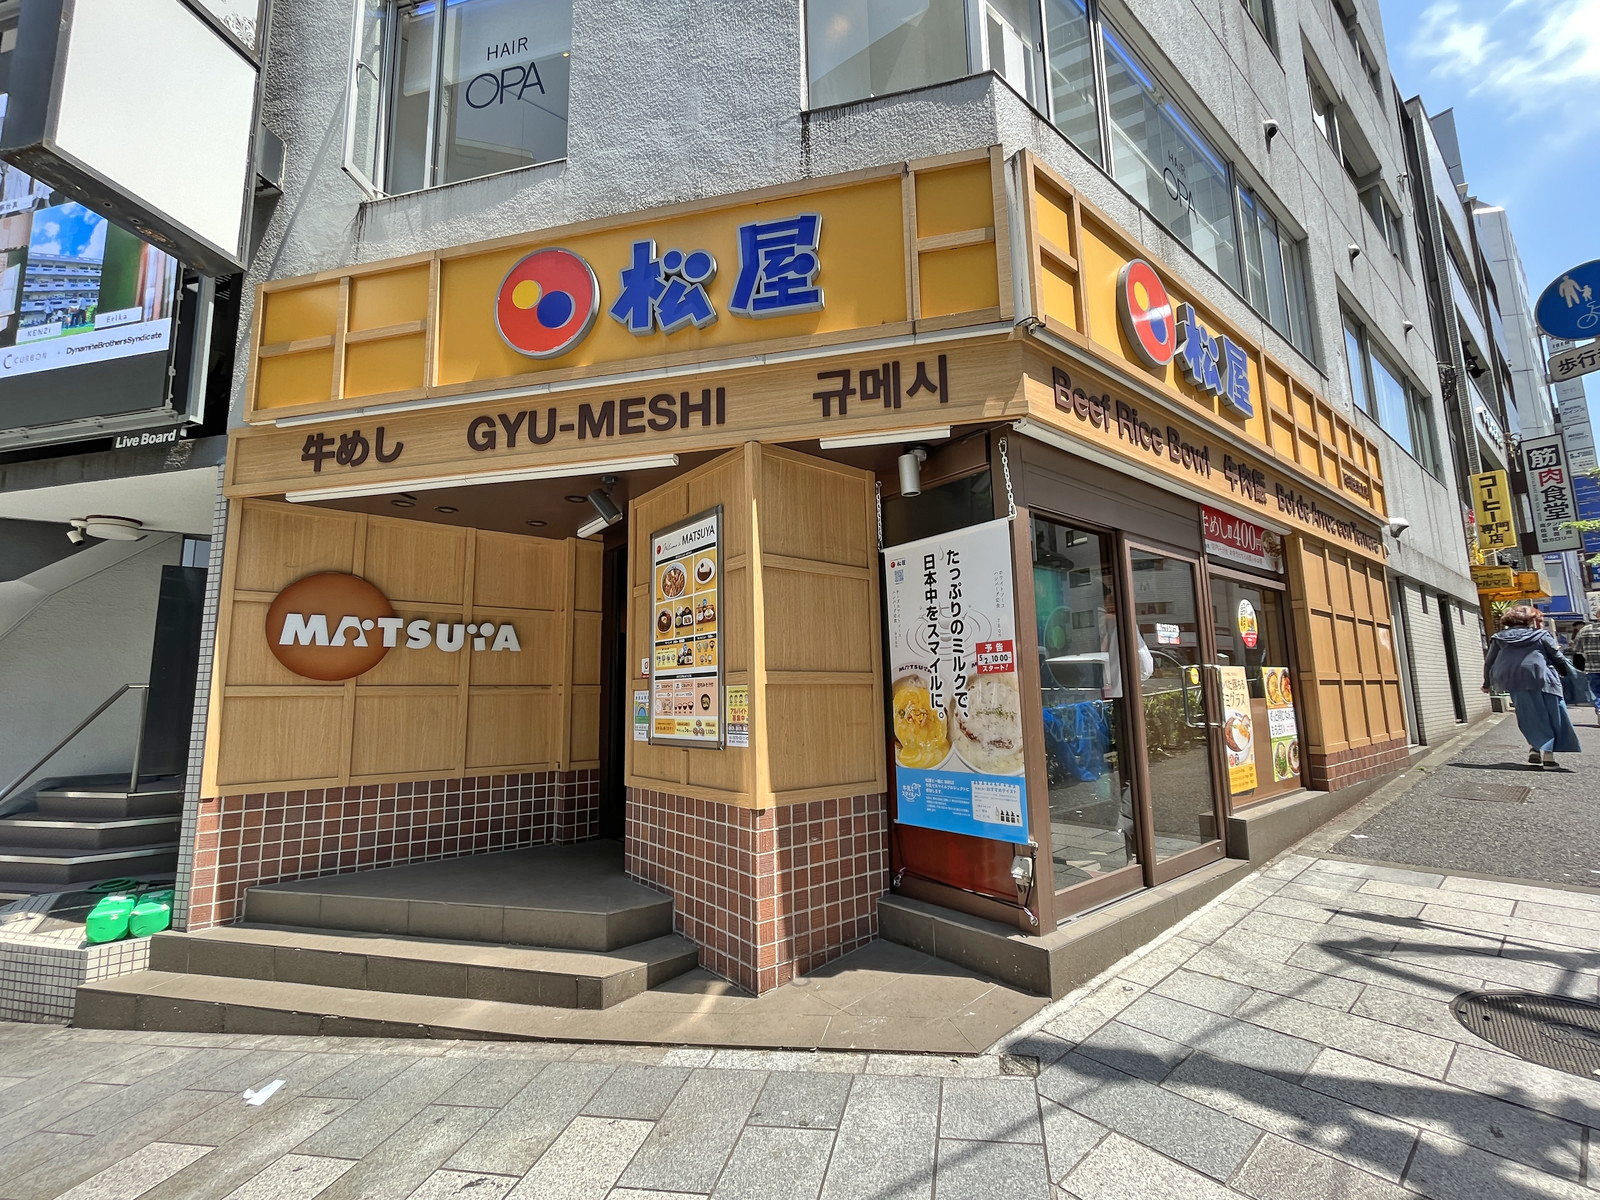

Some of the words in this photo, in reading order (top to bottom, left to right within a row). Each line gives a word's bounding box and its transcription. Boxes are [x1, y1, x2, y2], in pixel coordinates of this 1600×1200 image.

[487, 37, 528, 61] HAIR
[465, 62, 546, 109] OPA
[1168, 150, 1187, 179] HAIR
[1163, 167, 1199, 225] OPA
[608, 212, 826, 337] 松屋
[26, 328, 51, 337] KENZI
[1174, 302, 1254, 420] 松屋
[1557, 348, 1600, 376] 歩行
[812, 355, 950, 417] 규메시
[115, 435, 139, 449] Live
[140, 429, 177, 446] Board
[467, 386, 727, 452] GYU-MESHI
[1052, 366, 1111, 433] Beef
[1116, 400, 1164, 456] Rice
[1167, 426, 1212, 479] Bowl
[301, 426, 405, 473] 牛めし
[1276, 482, 1296, 517] Bol
[1297, 495, 1311, 524] de
[1529, 448, 1571, 521] 筋肉食堂
[682, 525, 715, 545] MATSUYA
[279, 613, 521, 653] MATSUYA
[923, 554, 946, 719] 日本中をスマイルに。
[946, 550, 969, 718] たっぷりのミルクで、
[984, 643, 1004, 653] 予告
[898, 664, 932, 675] MATSUYA
[982, 663, 1009, 672] スタート!
